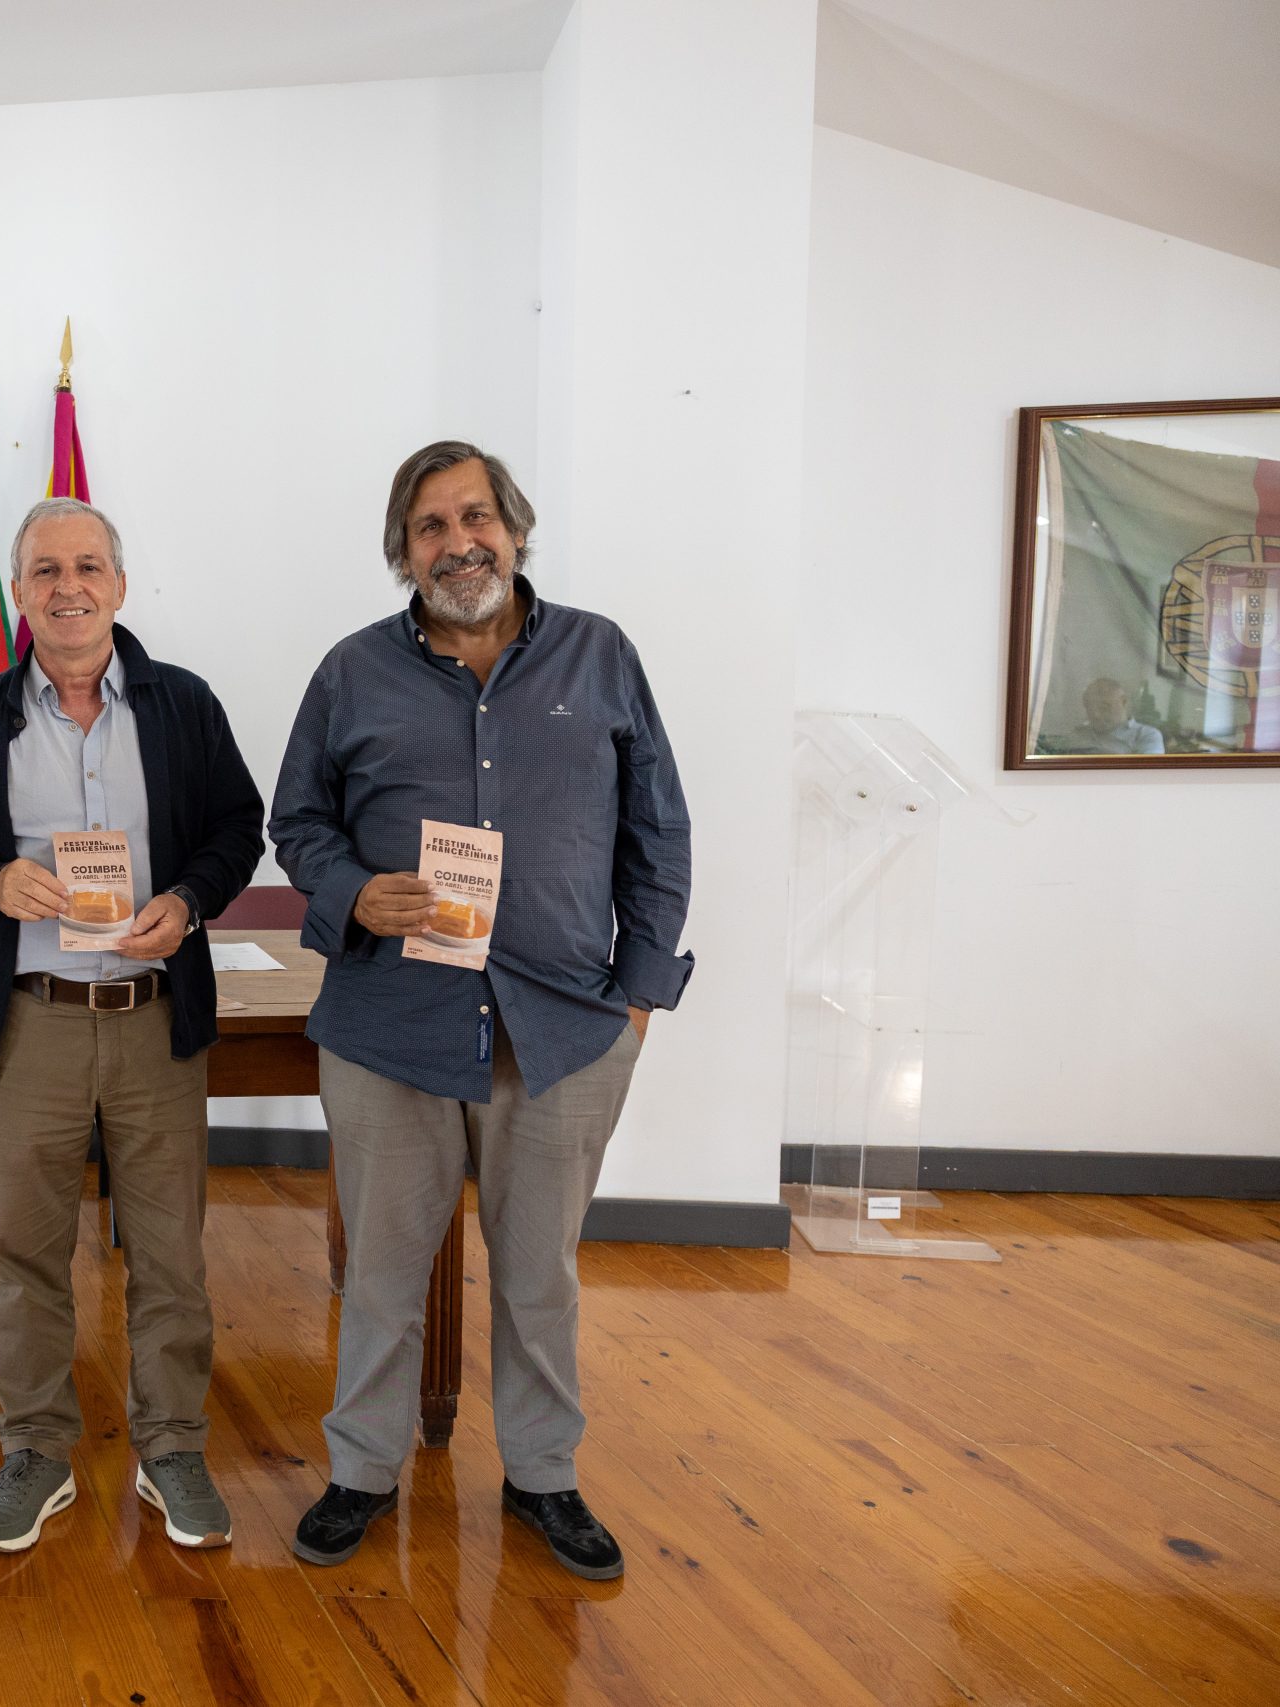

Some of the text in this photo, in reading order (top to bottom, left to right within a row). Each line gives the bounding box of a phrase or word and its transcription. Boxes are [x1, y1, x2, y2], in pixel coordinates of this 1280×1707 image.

[59, 844, 126, 853] FRANCESINHAS
[433, 837, 476, 851] FESTIVAL
[426, 843, 499, 862] FRANCESINHAS
[71, 865, 126, 874] COIMBRA
[434, 870, 493, 888] COIMBRA
[476, 887, 493, 895] MAIO
